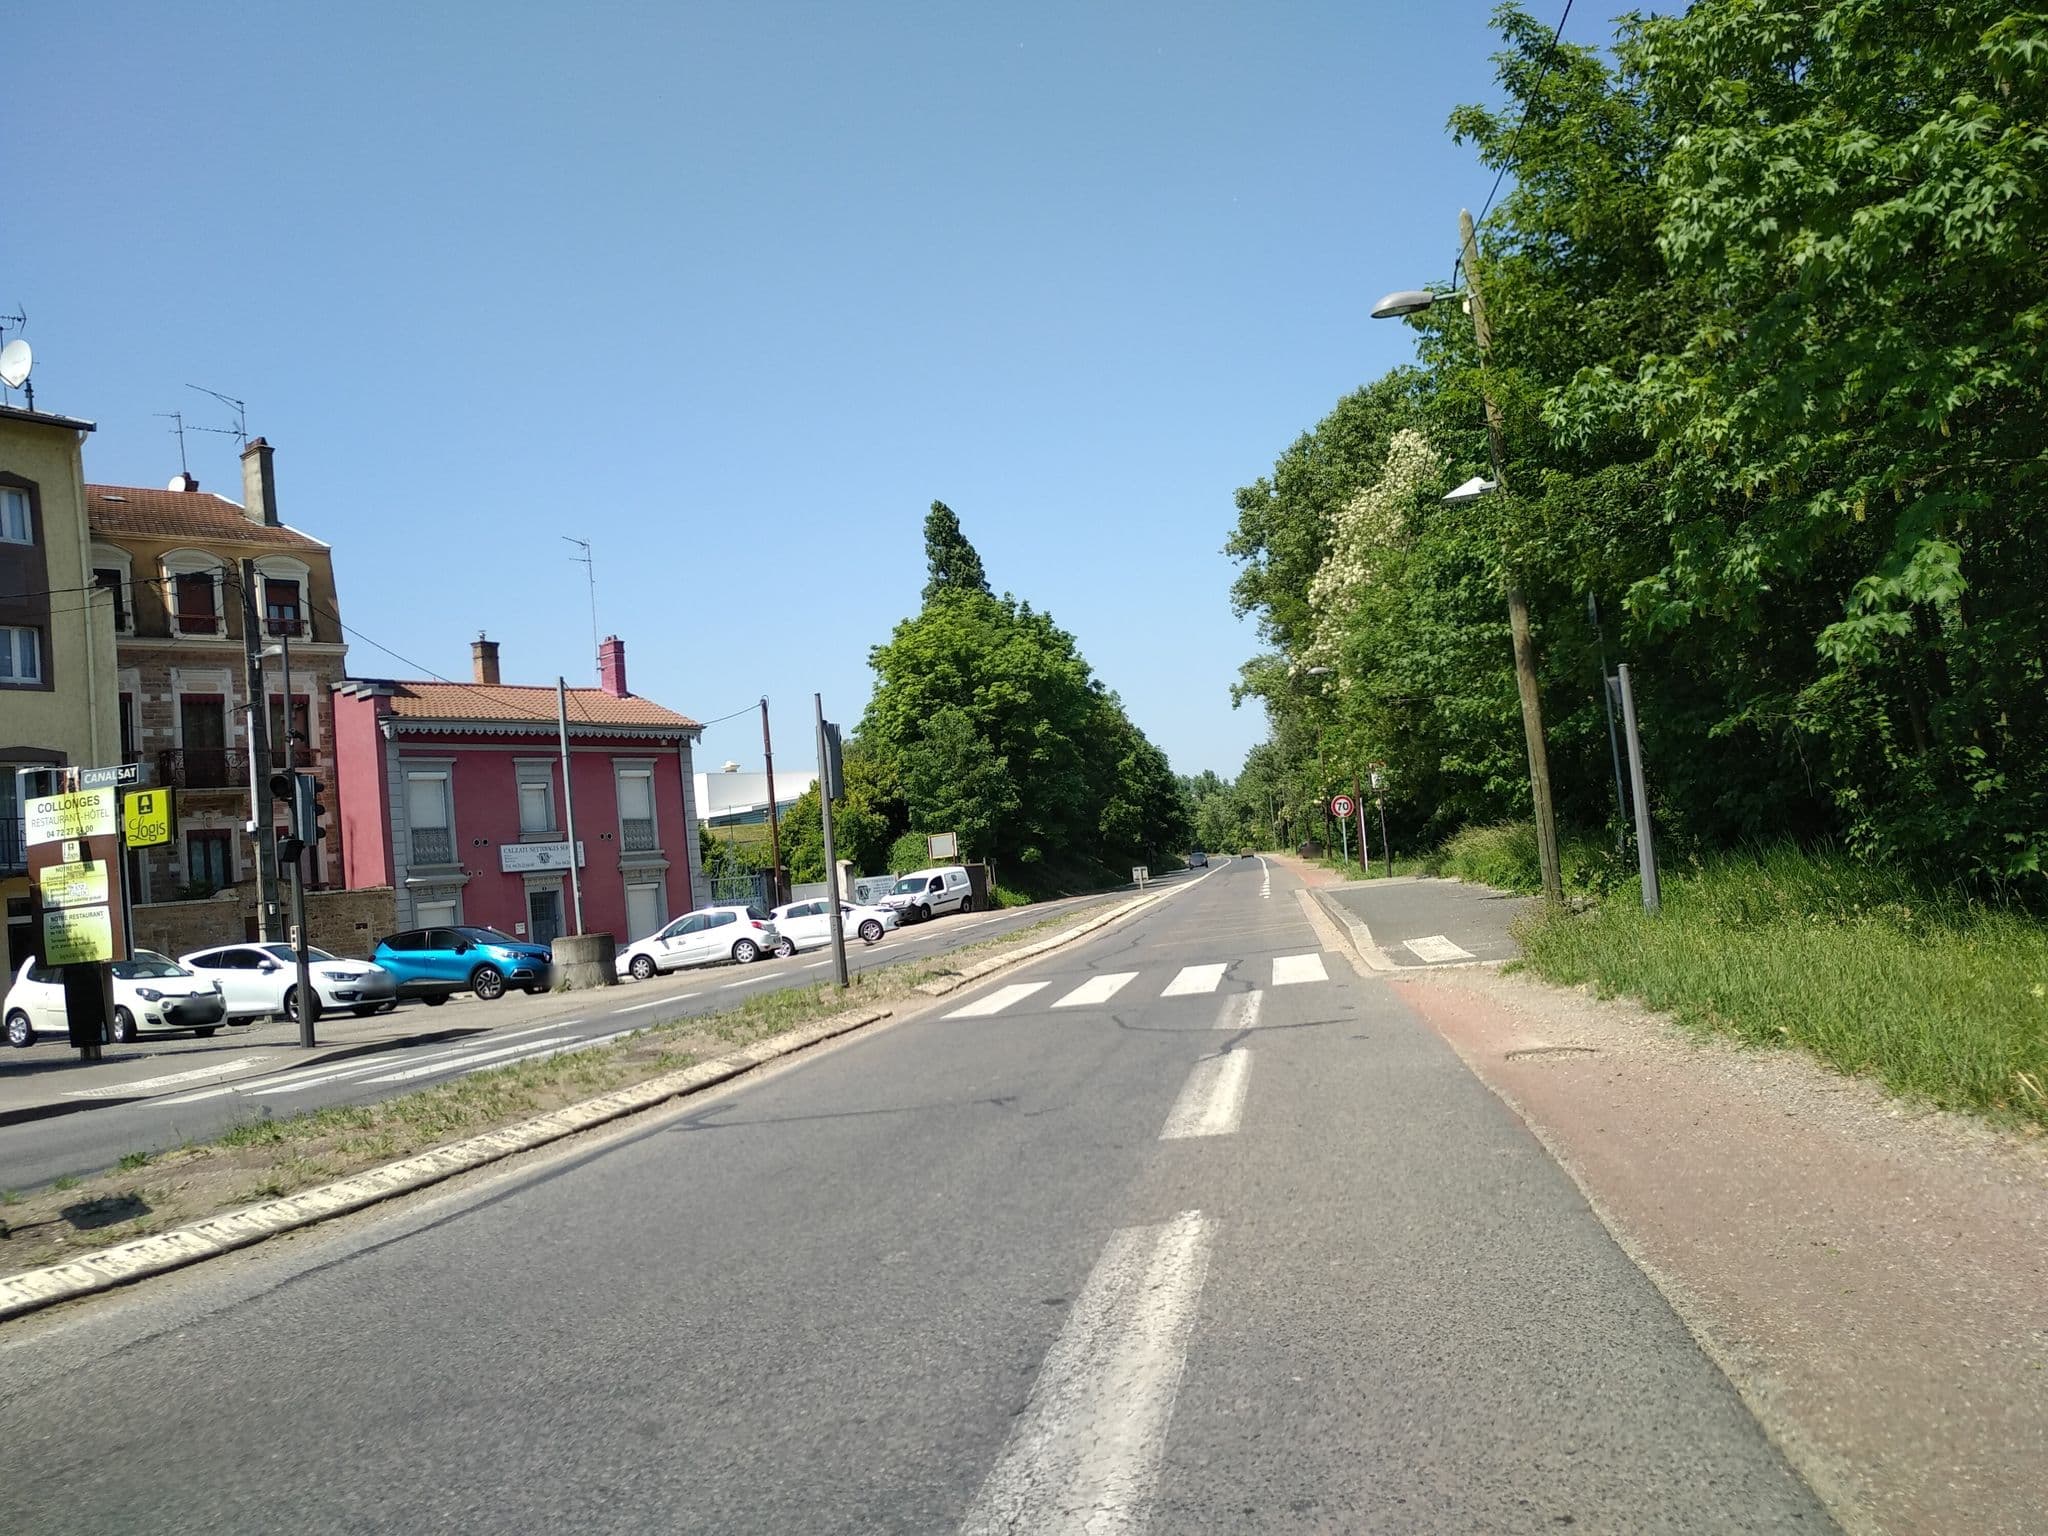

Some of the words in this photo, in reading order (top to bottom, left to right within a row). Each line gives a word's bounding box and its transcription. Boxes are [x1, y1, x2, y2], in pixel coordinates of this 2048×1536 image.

[84, 767, 136, 784] CANALSAT
[37, 795, 100, 814] COLLONGES
[1336, 802, 1349, 811] 70
[46, 830, 55, 838] 04
[56, 828, 65, 837] 72
[66, 827, 74, 836] 27
[128, 816, 166, 842] Logis
[69, 911, 105, 920] RESTAURANT
